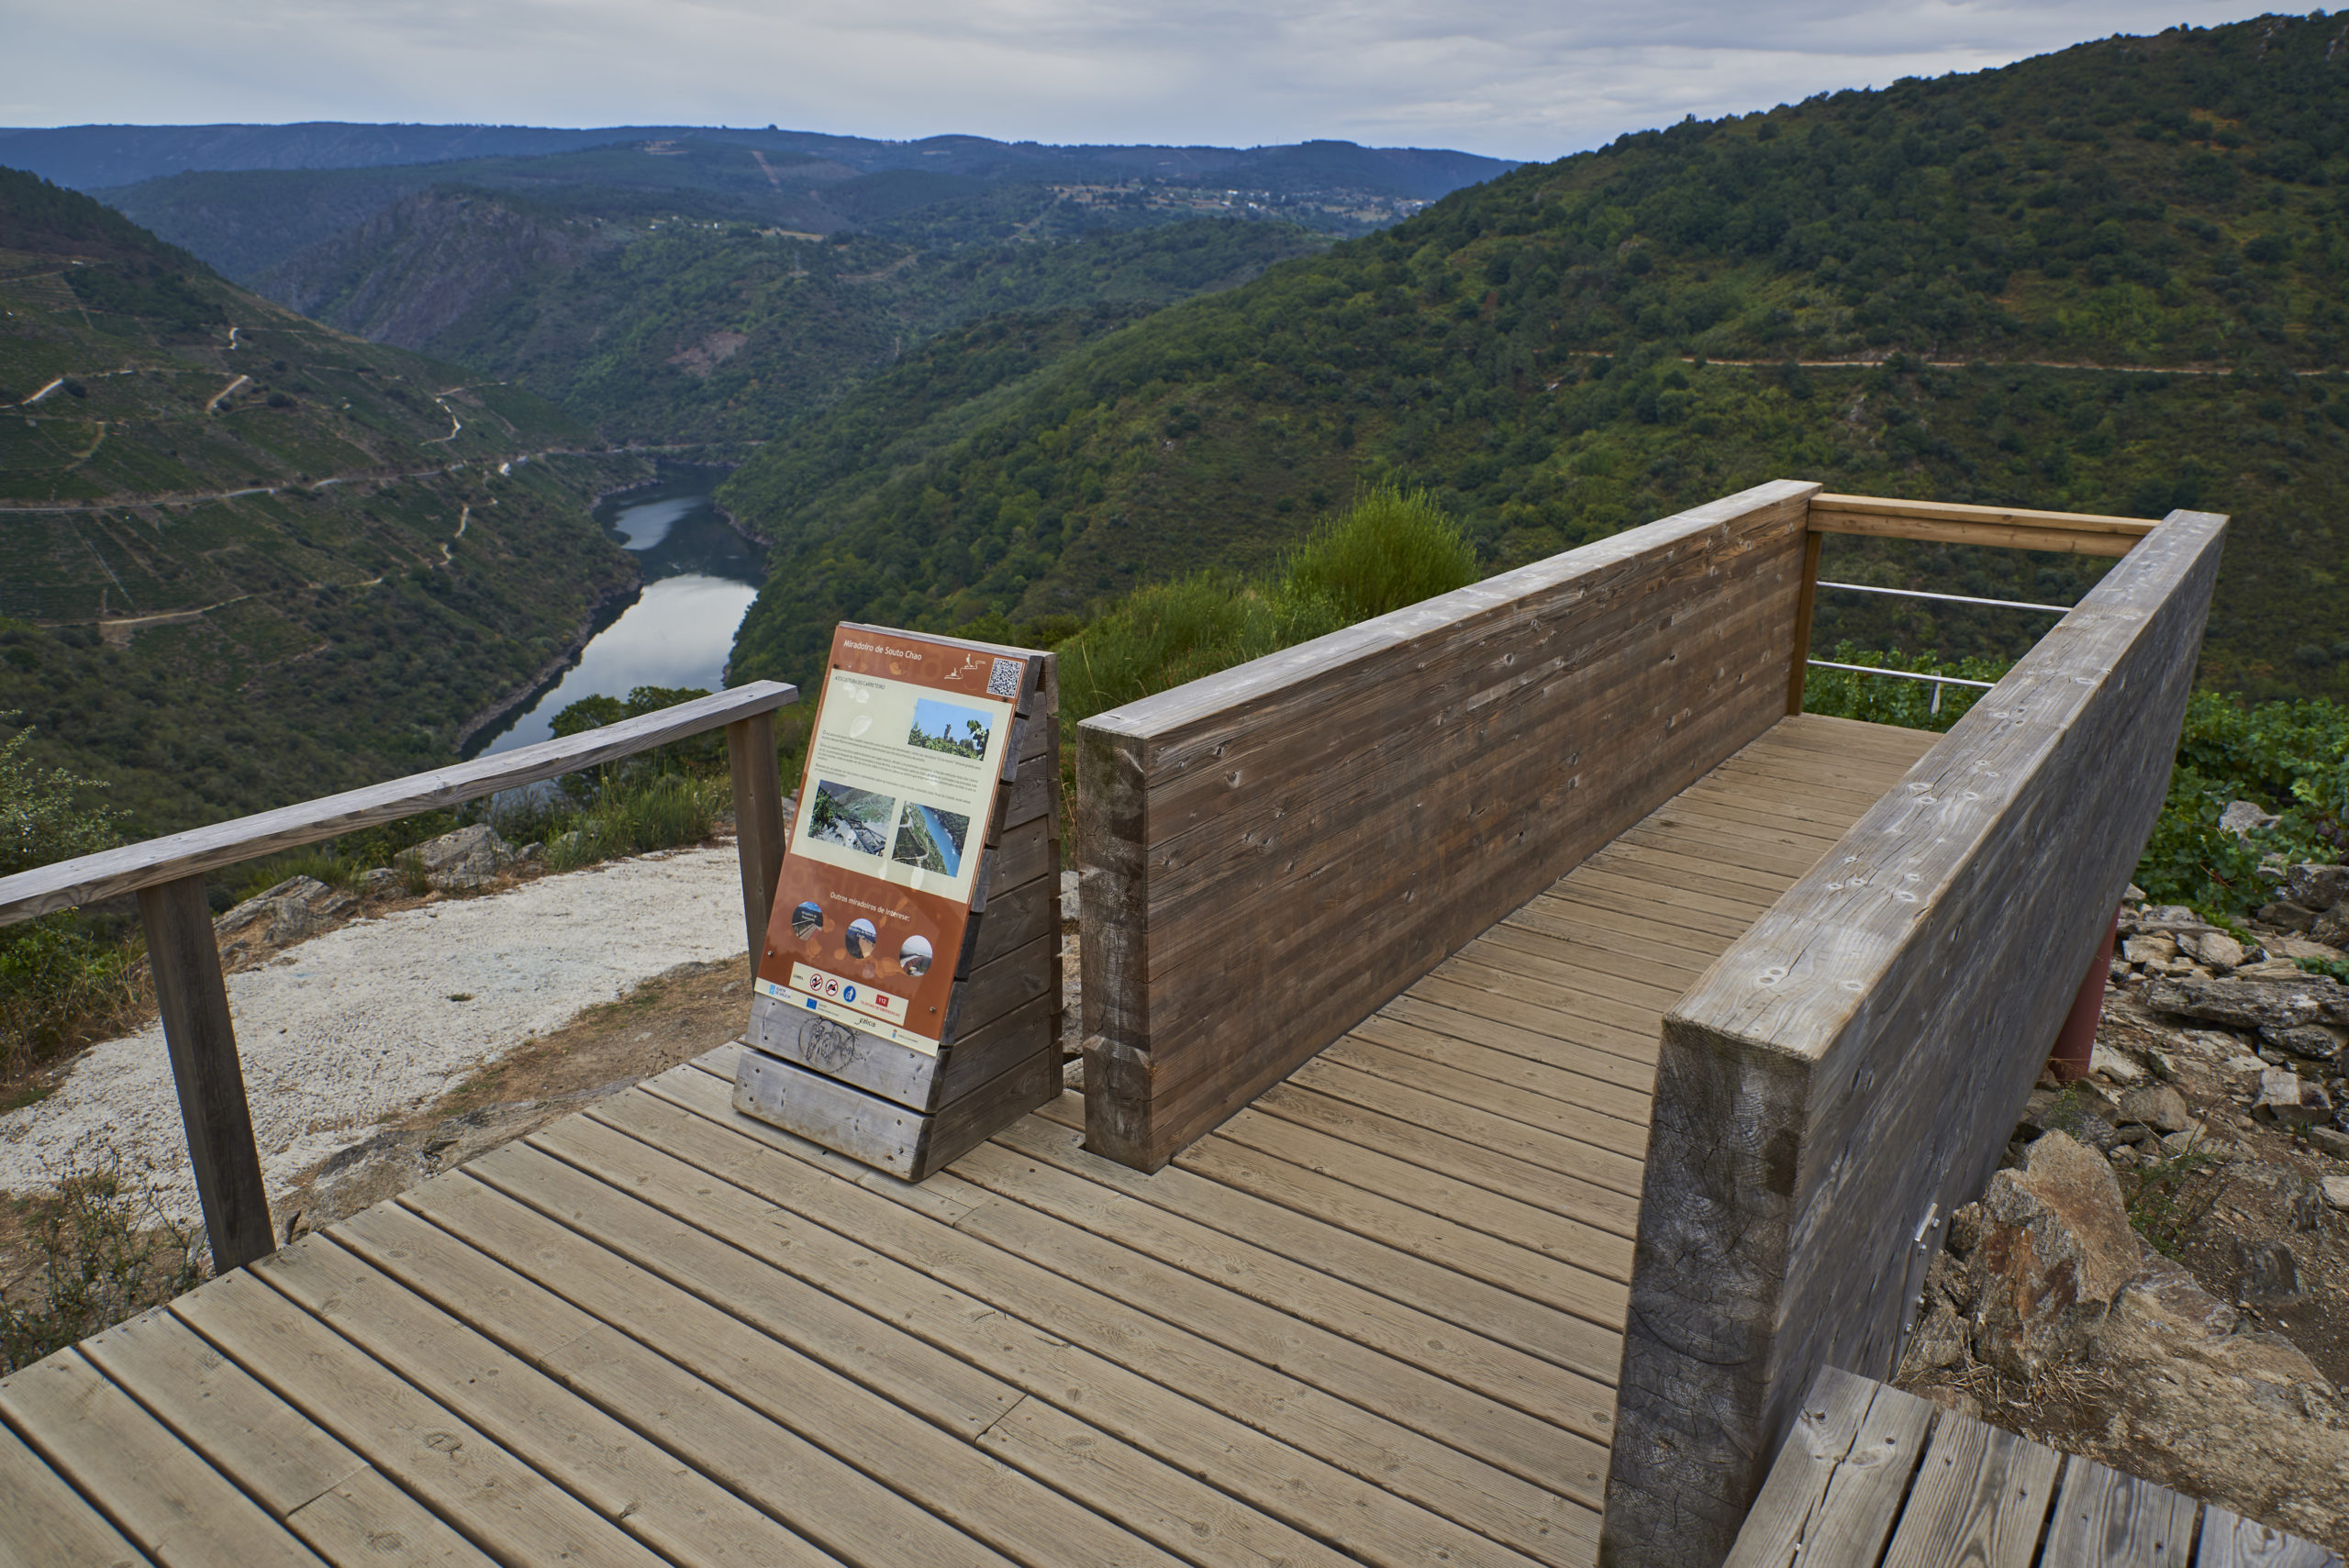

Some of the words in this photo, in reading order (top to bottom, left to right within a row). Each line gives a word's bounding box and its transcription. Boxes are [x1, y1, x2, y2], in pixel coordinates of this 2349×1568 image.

[843, 639, 874, 651] Miradoiro
[874, 645, 884, 653] de
[885, 646, 904, 657] Souto
[905, 650, 922, 661] Chao
[829, 891, 848, 903] Outros
[848, 897, 876, 911] miradoiros
[877, 906, 885, 914] de
[885, 907, 910, 922] interese:
[853, 1017, 876, 1028] galicia
